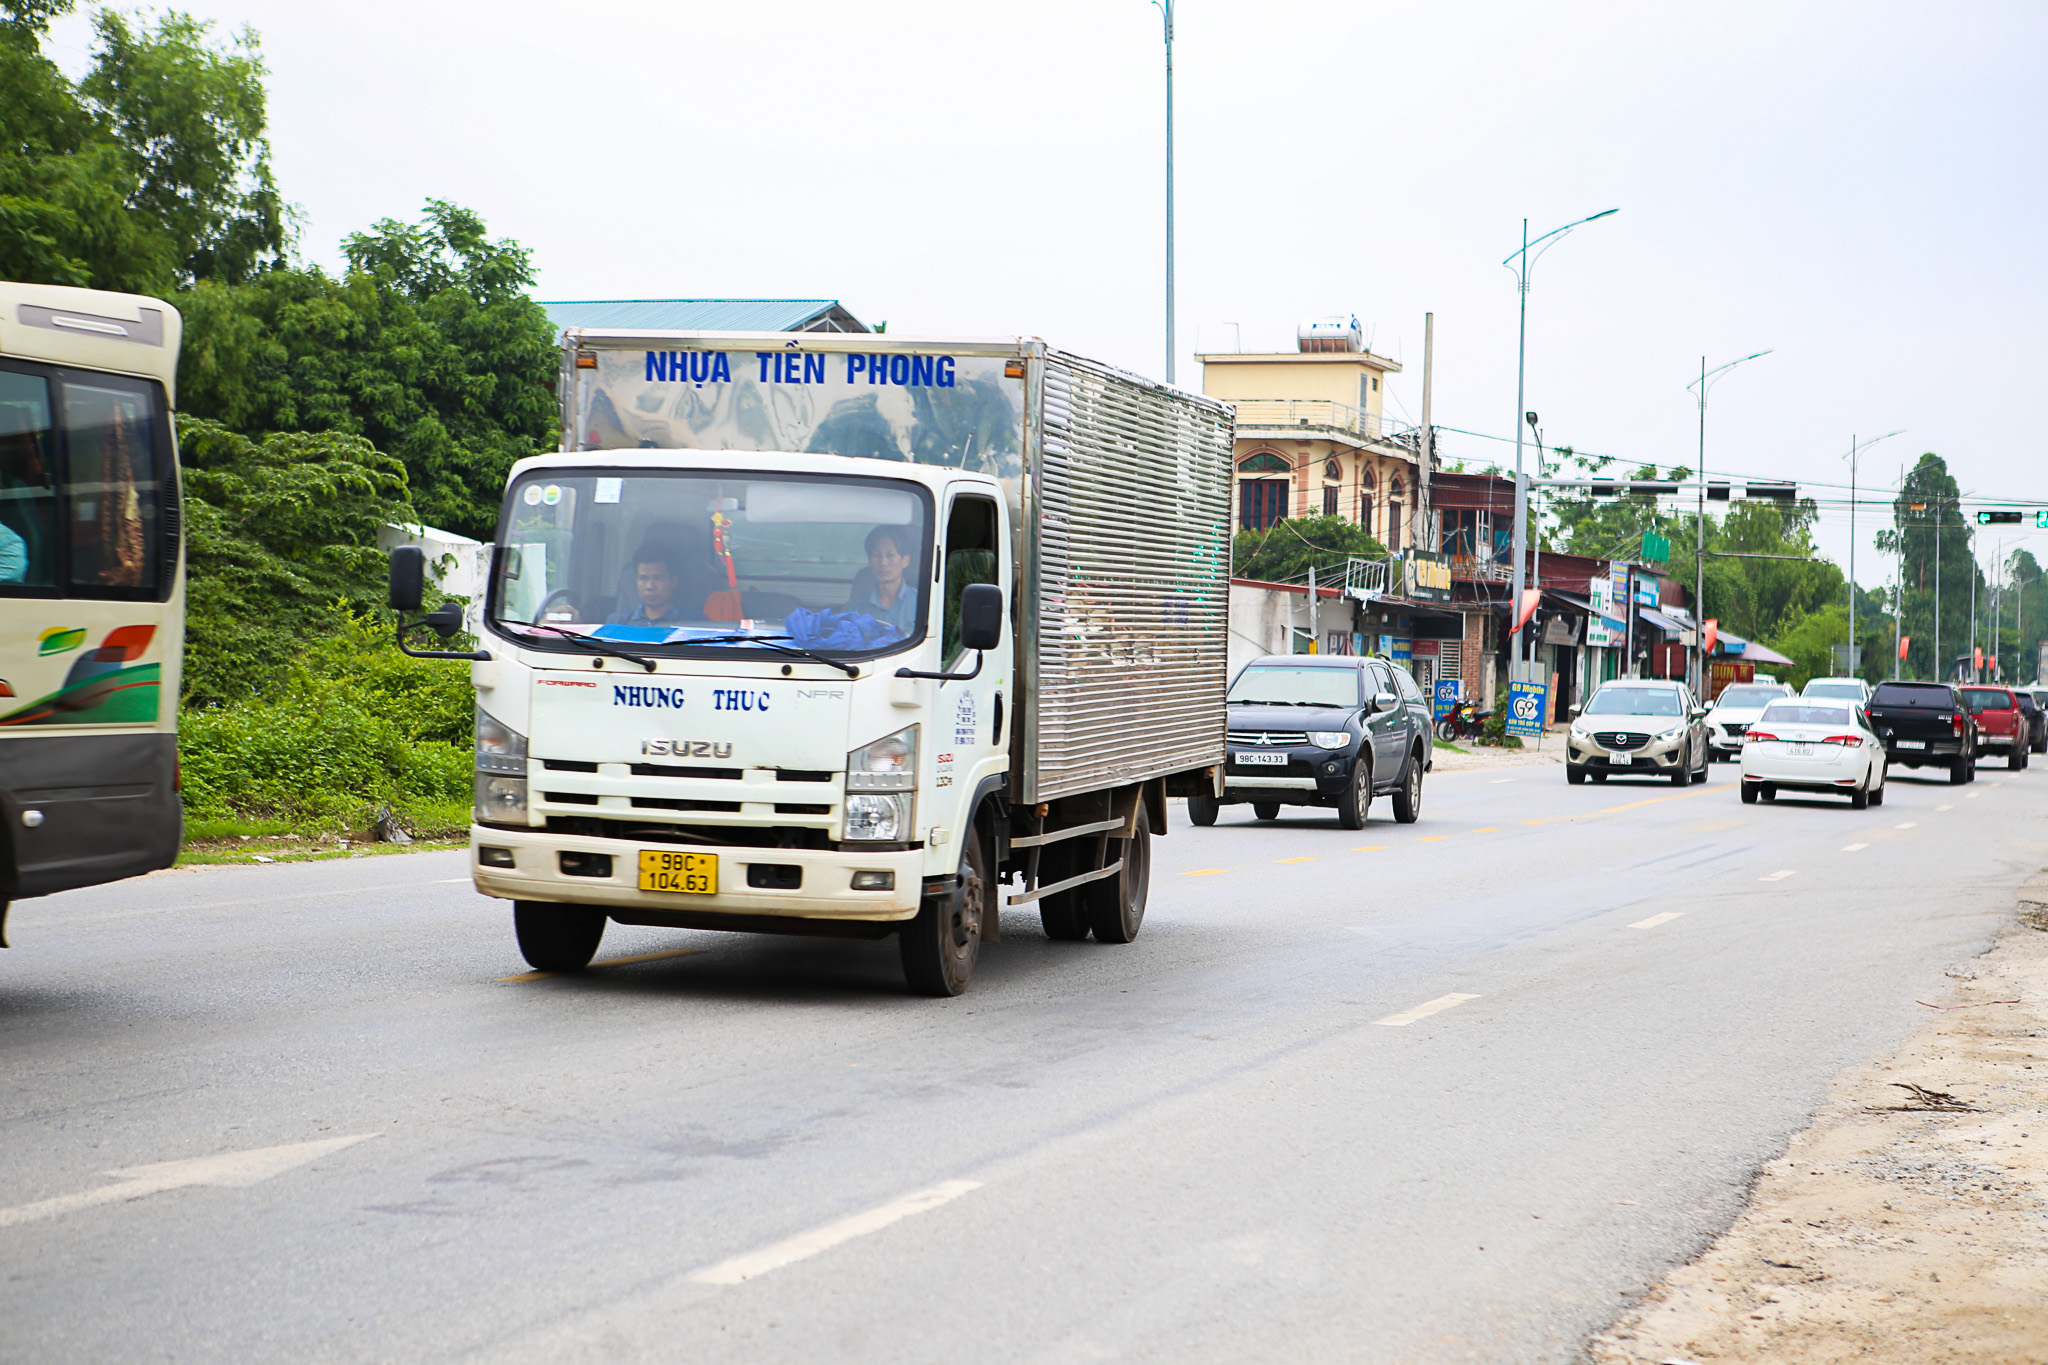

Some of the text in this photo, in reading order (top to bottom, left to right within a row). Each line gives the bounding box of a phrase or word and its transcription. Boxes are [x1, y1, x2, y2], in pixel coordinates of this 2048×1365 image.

[645, 340, 955, 388] NHỰA TIỀN PHONG
[613, 685, 685, 709] NHUNG
[797, 689, 845, 700] NPR
[641, 738, 733, 759] ISUZU
[661, 853, 696, 872] 98C
[649, 872, 708, 892] 104.63
